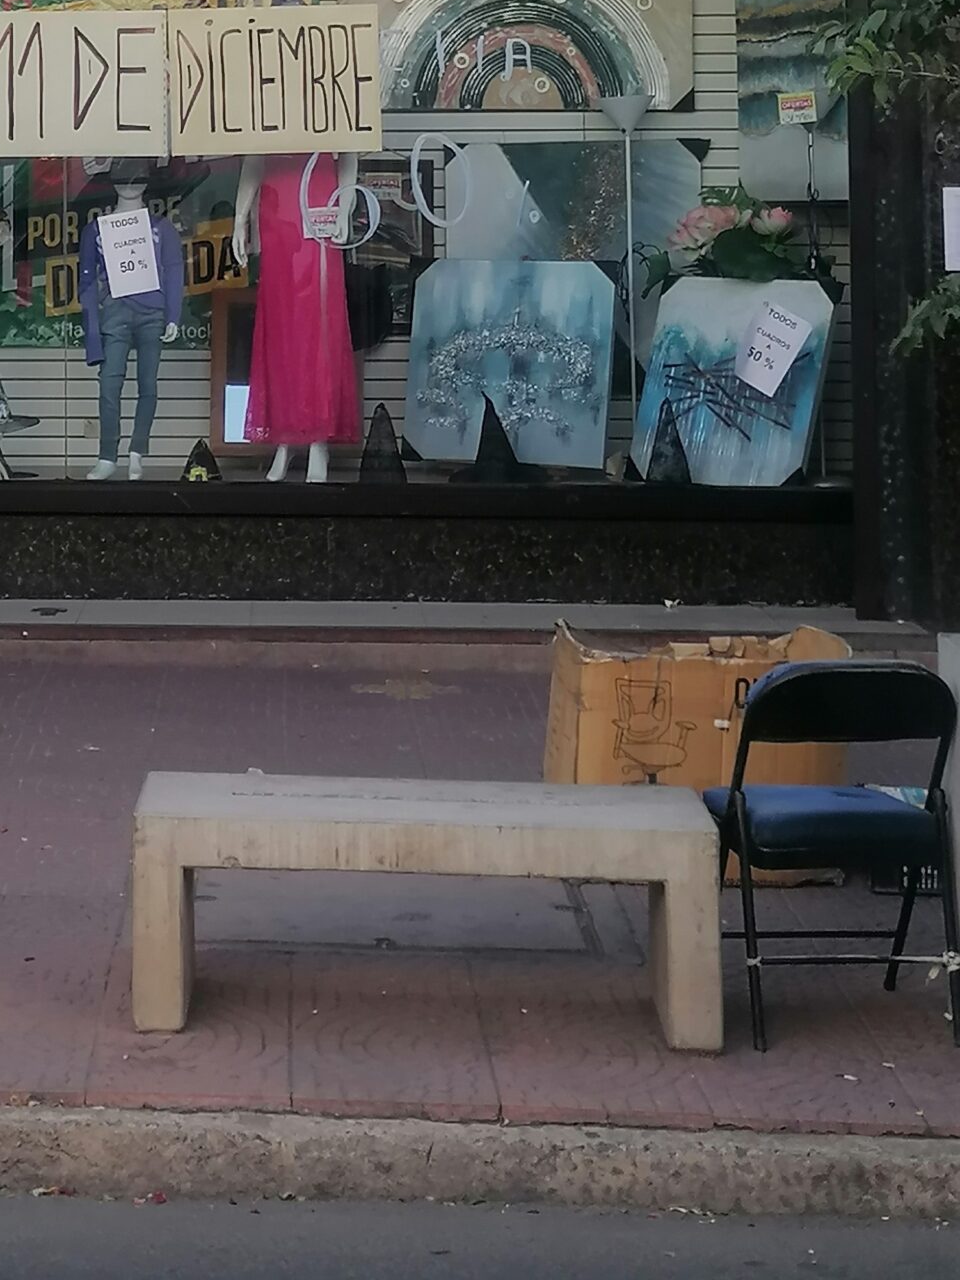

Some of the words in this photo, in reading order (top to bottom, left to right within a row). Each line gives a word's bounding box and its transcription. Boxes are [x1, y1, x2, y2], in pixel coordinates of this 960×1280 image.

[73, 26, 157, 133] DE
[176, 19, 373, 134] DICIEMBRE
[26, 210, 80, 251] POR
[110, 216, 139, 228] TODOS
[113, 237, 146, 249] CUADROS
[120, 260, 135, 273] 50
[768, 307, 798, 330] TODOS
[756, 327, 791, 351] CUADROS
[747, 346, 763, 362] 50
